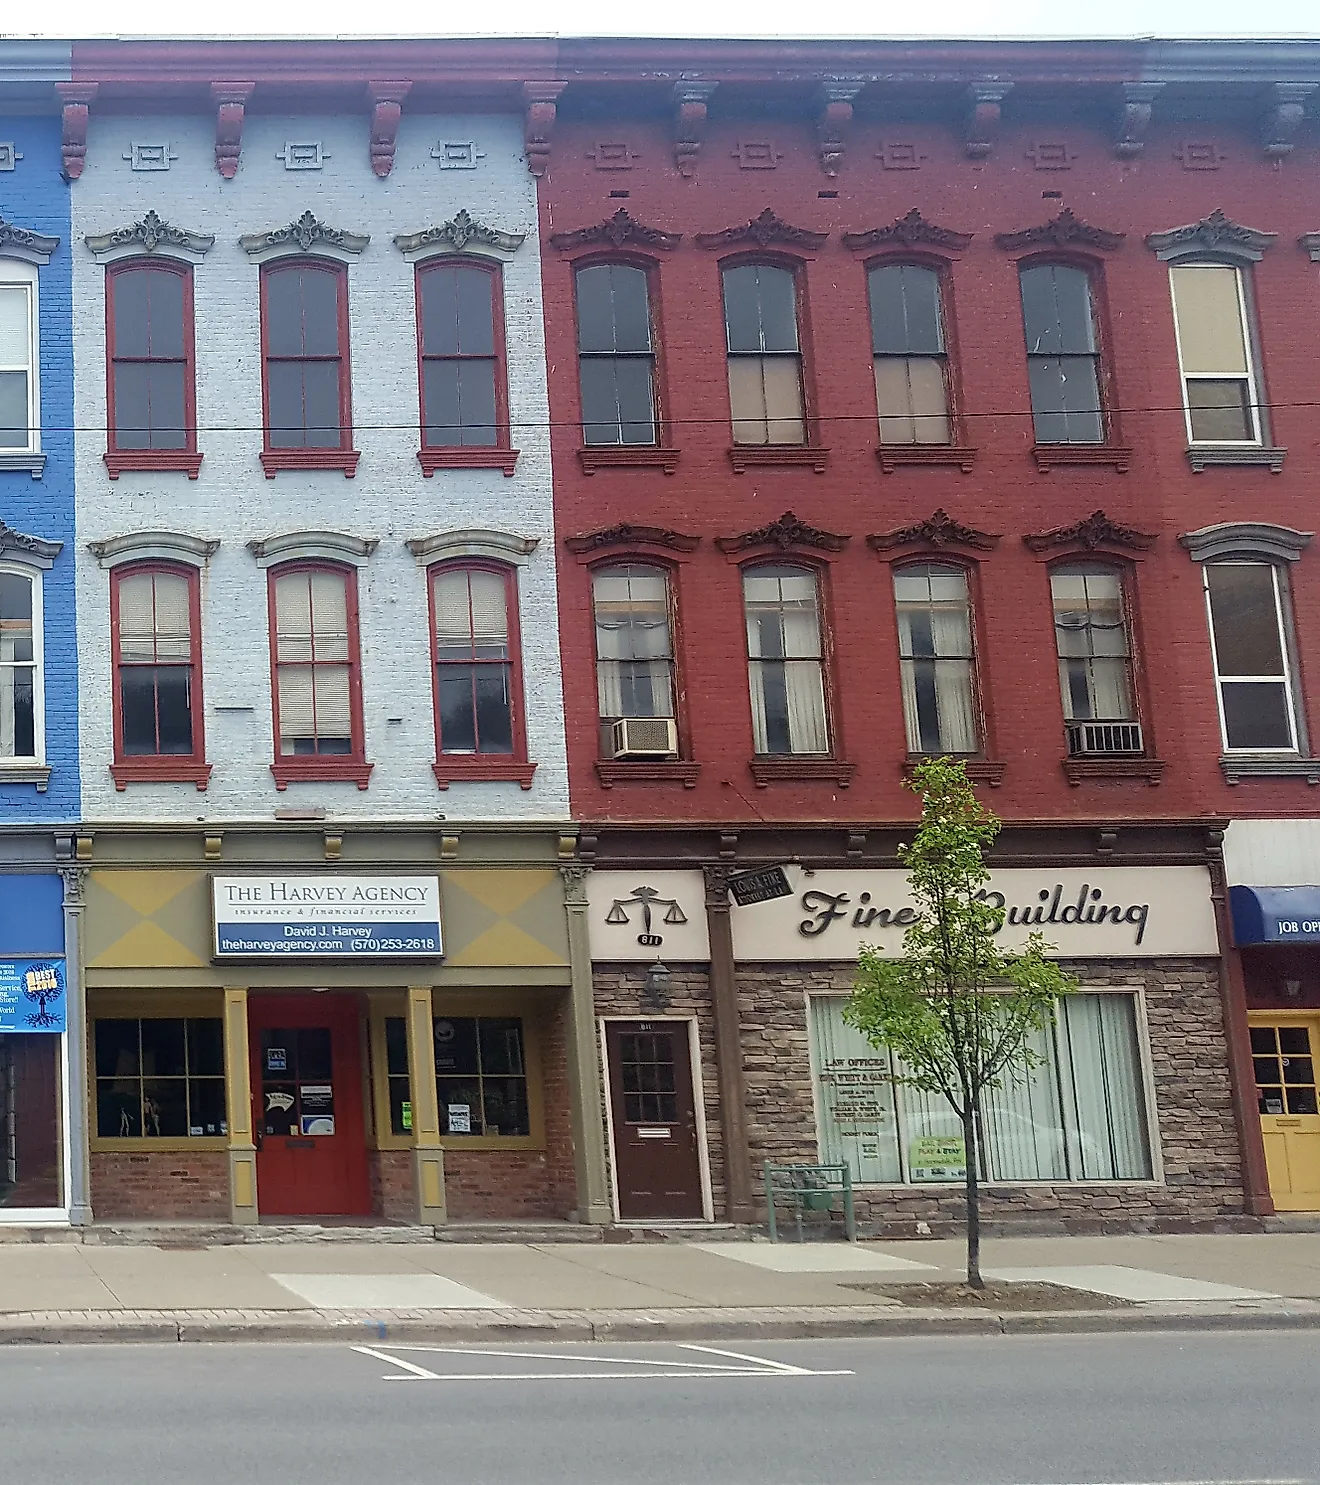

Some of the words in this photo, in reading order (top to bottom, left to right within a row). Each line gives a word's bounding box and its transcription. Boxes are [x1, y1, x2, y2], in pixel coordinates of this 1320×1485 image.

[224, 885, 262, 901] THE
[269, 882, 347, 901] HARVEY
[352, 885, 428, 901] AGENCY
[235, 907, 292, 915] insurance
[297, 907, 305, 916] &
[308, 906, 365, 917] financial
[370, 907, 418, 915] services
[798, 888, 921, 938] Fine
[284, 926, 317, 937] David
[319, 926, 329, 937] J.
[332, 925, 373, 939] Harvey
[1278, 921, 1299, 934] JOB
[222, 939, 343, 951] theharveyagency.com
[641, 935, 659, 945] 811
[35, 969, 55, 980] BEST
[825, 1059, 845, 1067] LAW
[847, 1059, 885, 1067] OFFICES
